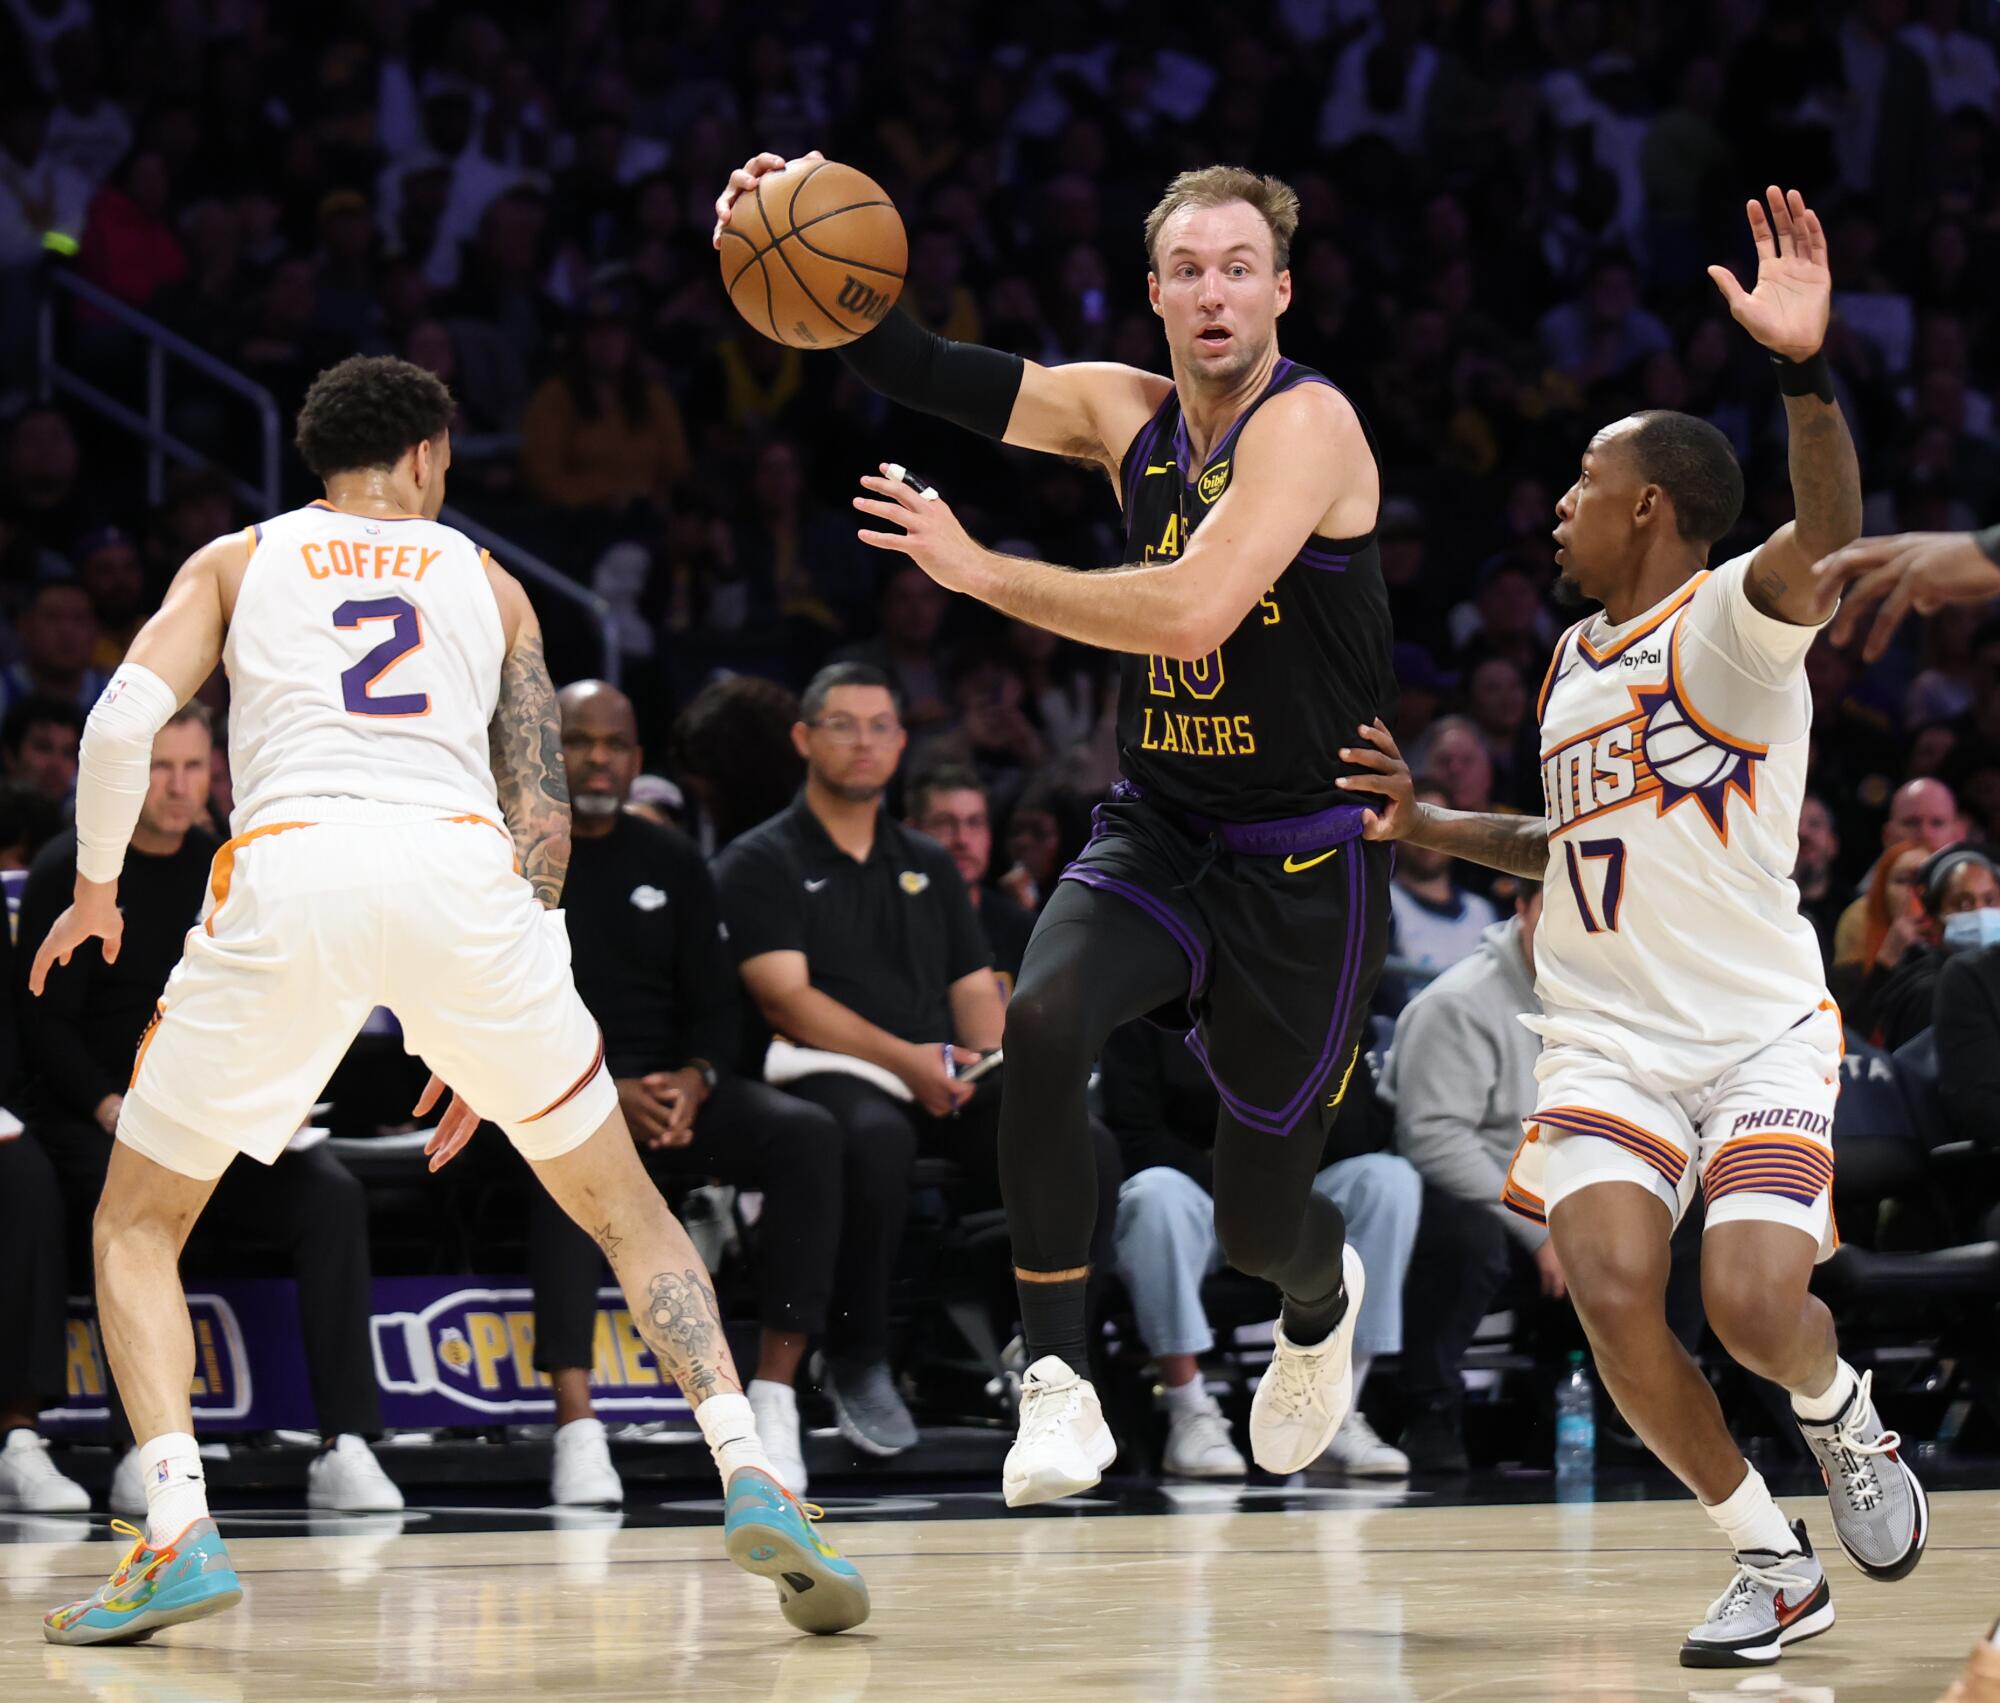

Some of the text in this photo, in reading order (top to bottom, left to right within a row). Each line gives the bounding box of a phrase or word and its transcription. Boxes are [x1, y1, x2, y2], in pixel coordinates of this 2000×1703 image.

[300, 540, 443, 581] COFFEY
[332, 596, 432, 718] 2
[1619, 648, 1661, 671] PayPal
[1141, 708, 1256, 755] LAKERS
[1542, 724, 1637, 834] UNS
[1563, 838, 1627, 933] 17
[1730, 1107, 1831, 1138] PHOENIX
